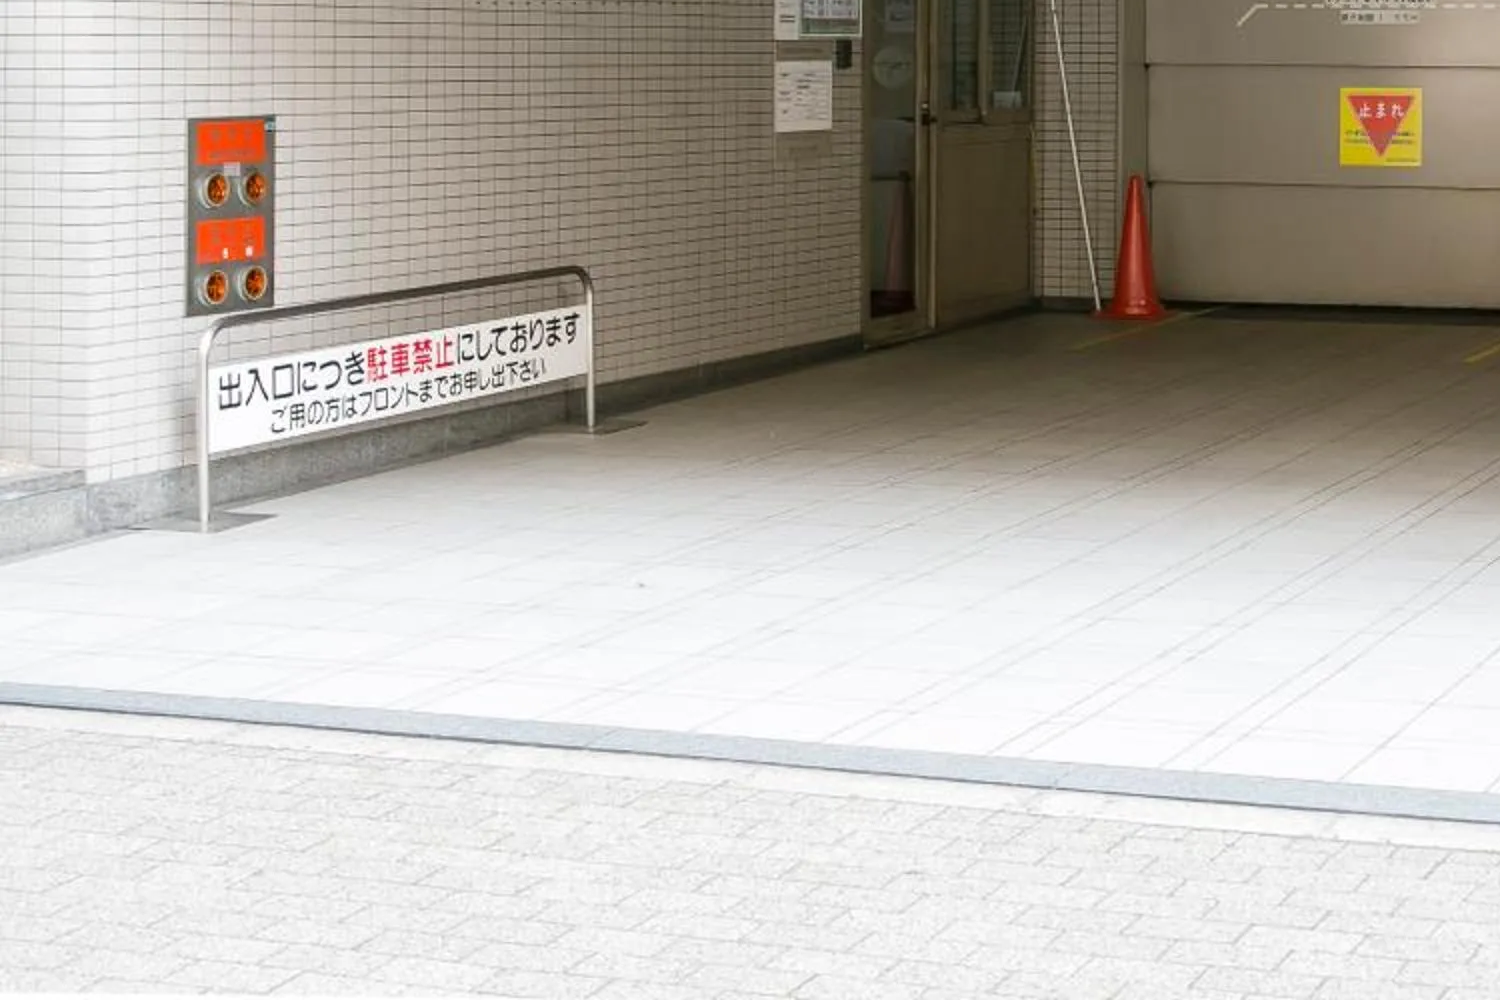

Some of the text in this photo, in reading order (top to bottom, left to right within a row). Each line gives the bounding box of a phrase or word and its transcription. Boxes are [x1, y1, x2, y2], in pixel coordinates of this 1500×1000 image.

[1359, 103, 1405, 119] 止まれ
[270, 357, 548, 434] ご用の方はフロントまでお申し出下さい
